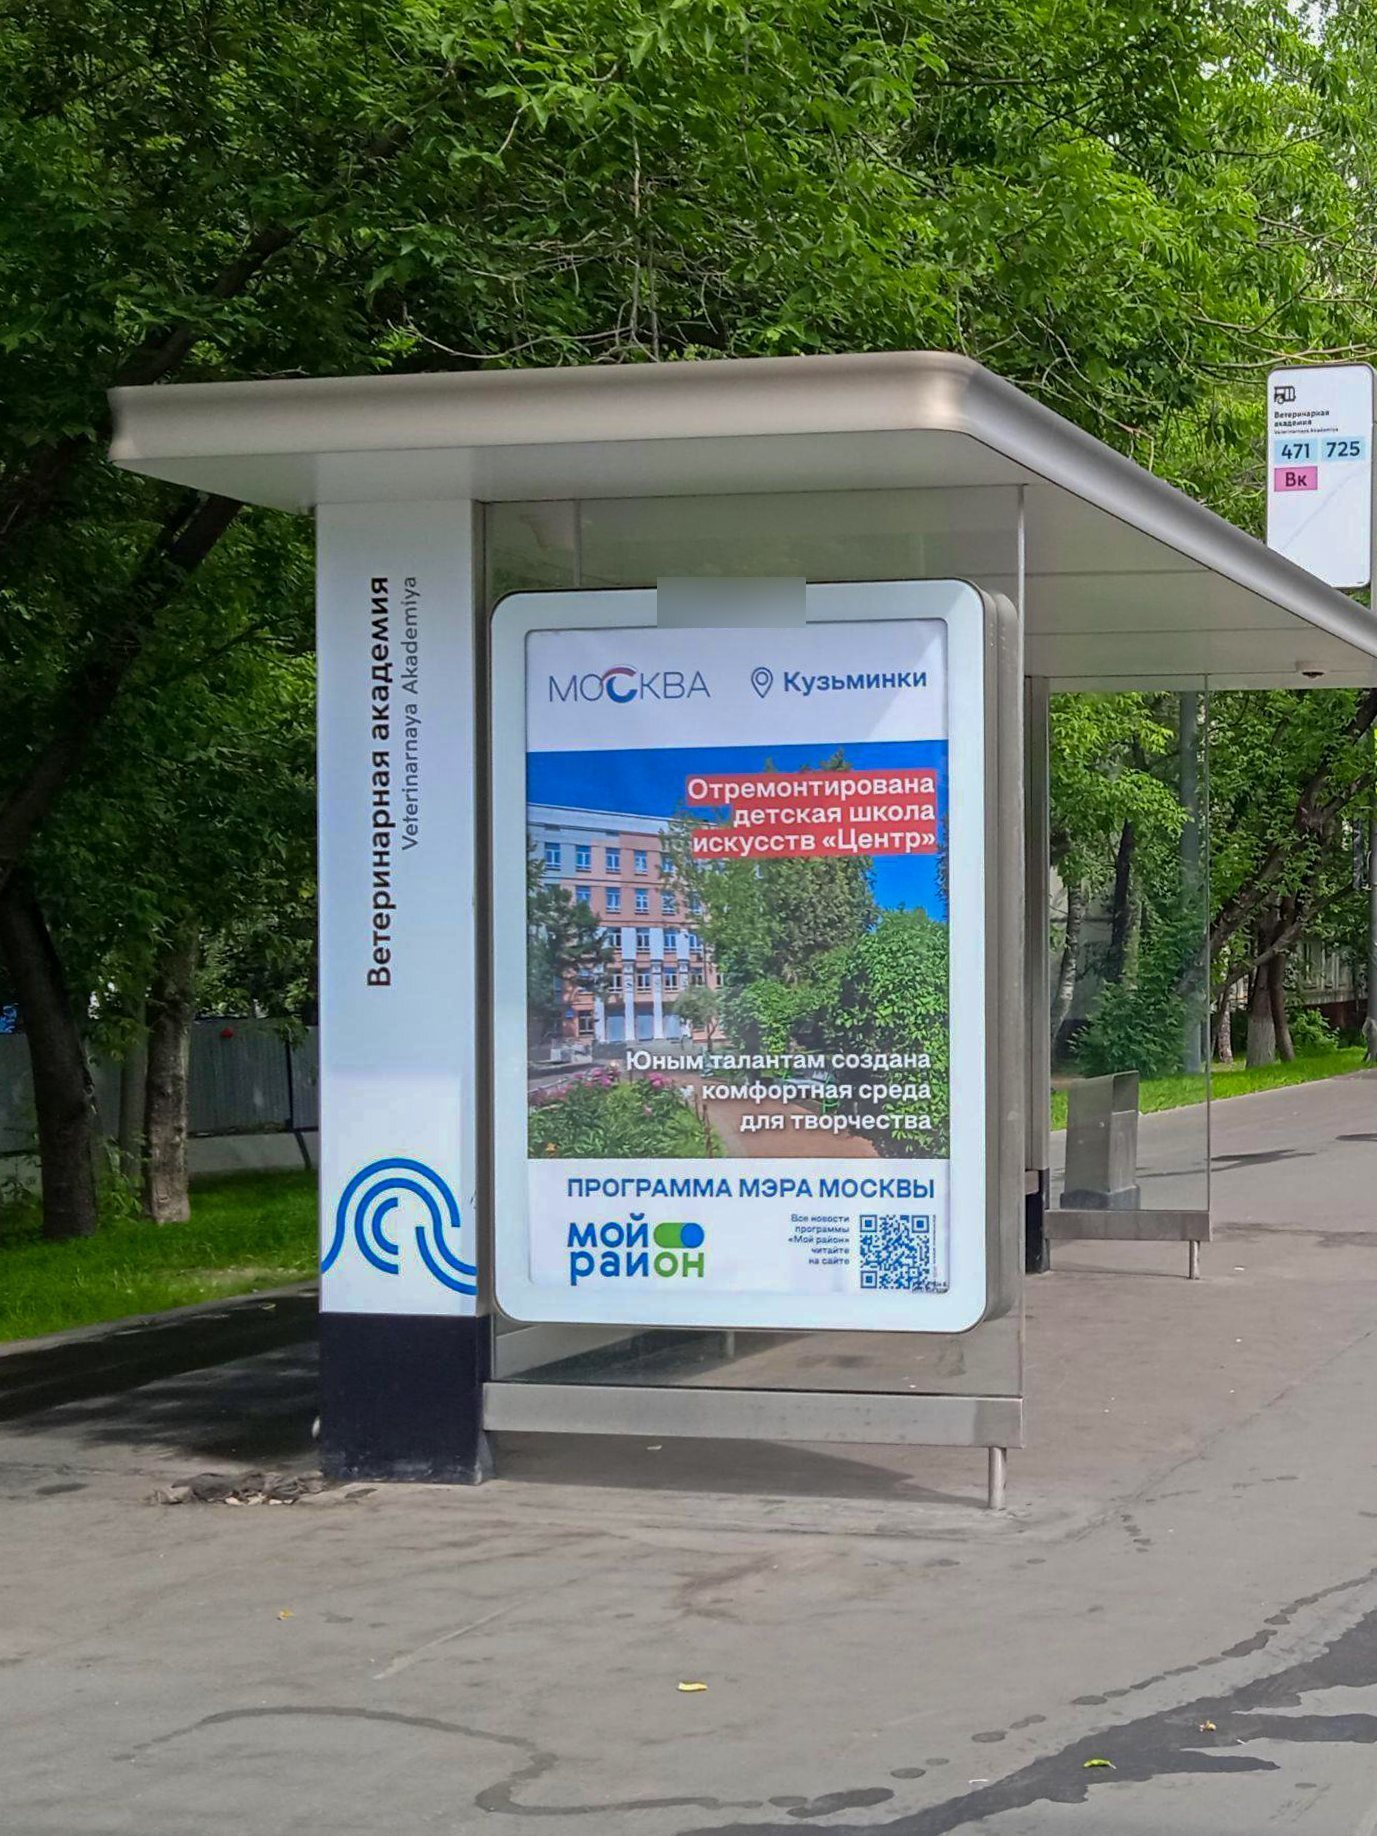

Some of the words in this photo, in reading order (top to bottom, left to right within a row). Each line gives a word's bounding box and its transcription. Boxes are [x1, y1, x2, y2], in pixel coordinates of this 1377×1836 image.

[1281, 444, 1310, 459] 471
[1326, 441, 1361, 457] 725
[1285, 472, 1308, 487] Вк
[402, 576, 422, 694] Akademiya
[370, 576, 394, 740] академия
[549, 664, 711, 703] МОСКВА
[783, 671, 927, 695] Кузьминки
[402, 702, 422, 850] Veterinarnaya
[687, 774, 935, 802] Отремонтирована
[733, 808, 843, 827] детская
[849, 803, 935, 824] школа
[693, 832, 816, 856] искусств
[823, 829, 936, 853] «Центр»
[367, 751, 396, 988] Ветеринарная
[626, 1050, 703, 1071] Юным
[709, 1053, 825, 1069] талантам
[831, 1052, 931, 1072] создана
[702, 1082, 853, 1105] комфортная
[858, 1083, 932, 1103] среда
[740, 1114, 784, 1133] для
[793, 1114, 932, 1134] творчества
[567, 1178, 732, 1198] ПРОГРАММА
[739, 1178, 813, 1198] МЭРА
[819, 1179, 935, 1198] МОСКВЫ
[791, 1214, 809, 1222] Все
[811, 1214, 850, 1223] новости
[795, 1225, 850, 1234] программы
[811, 1246, 850, 1255] читайте
[816, 1235, 850, 1245] район»
[822, 1257, 850, 1265] сайте
